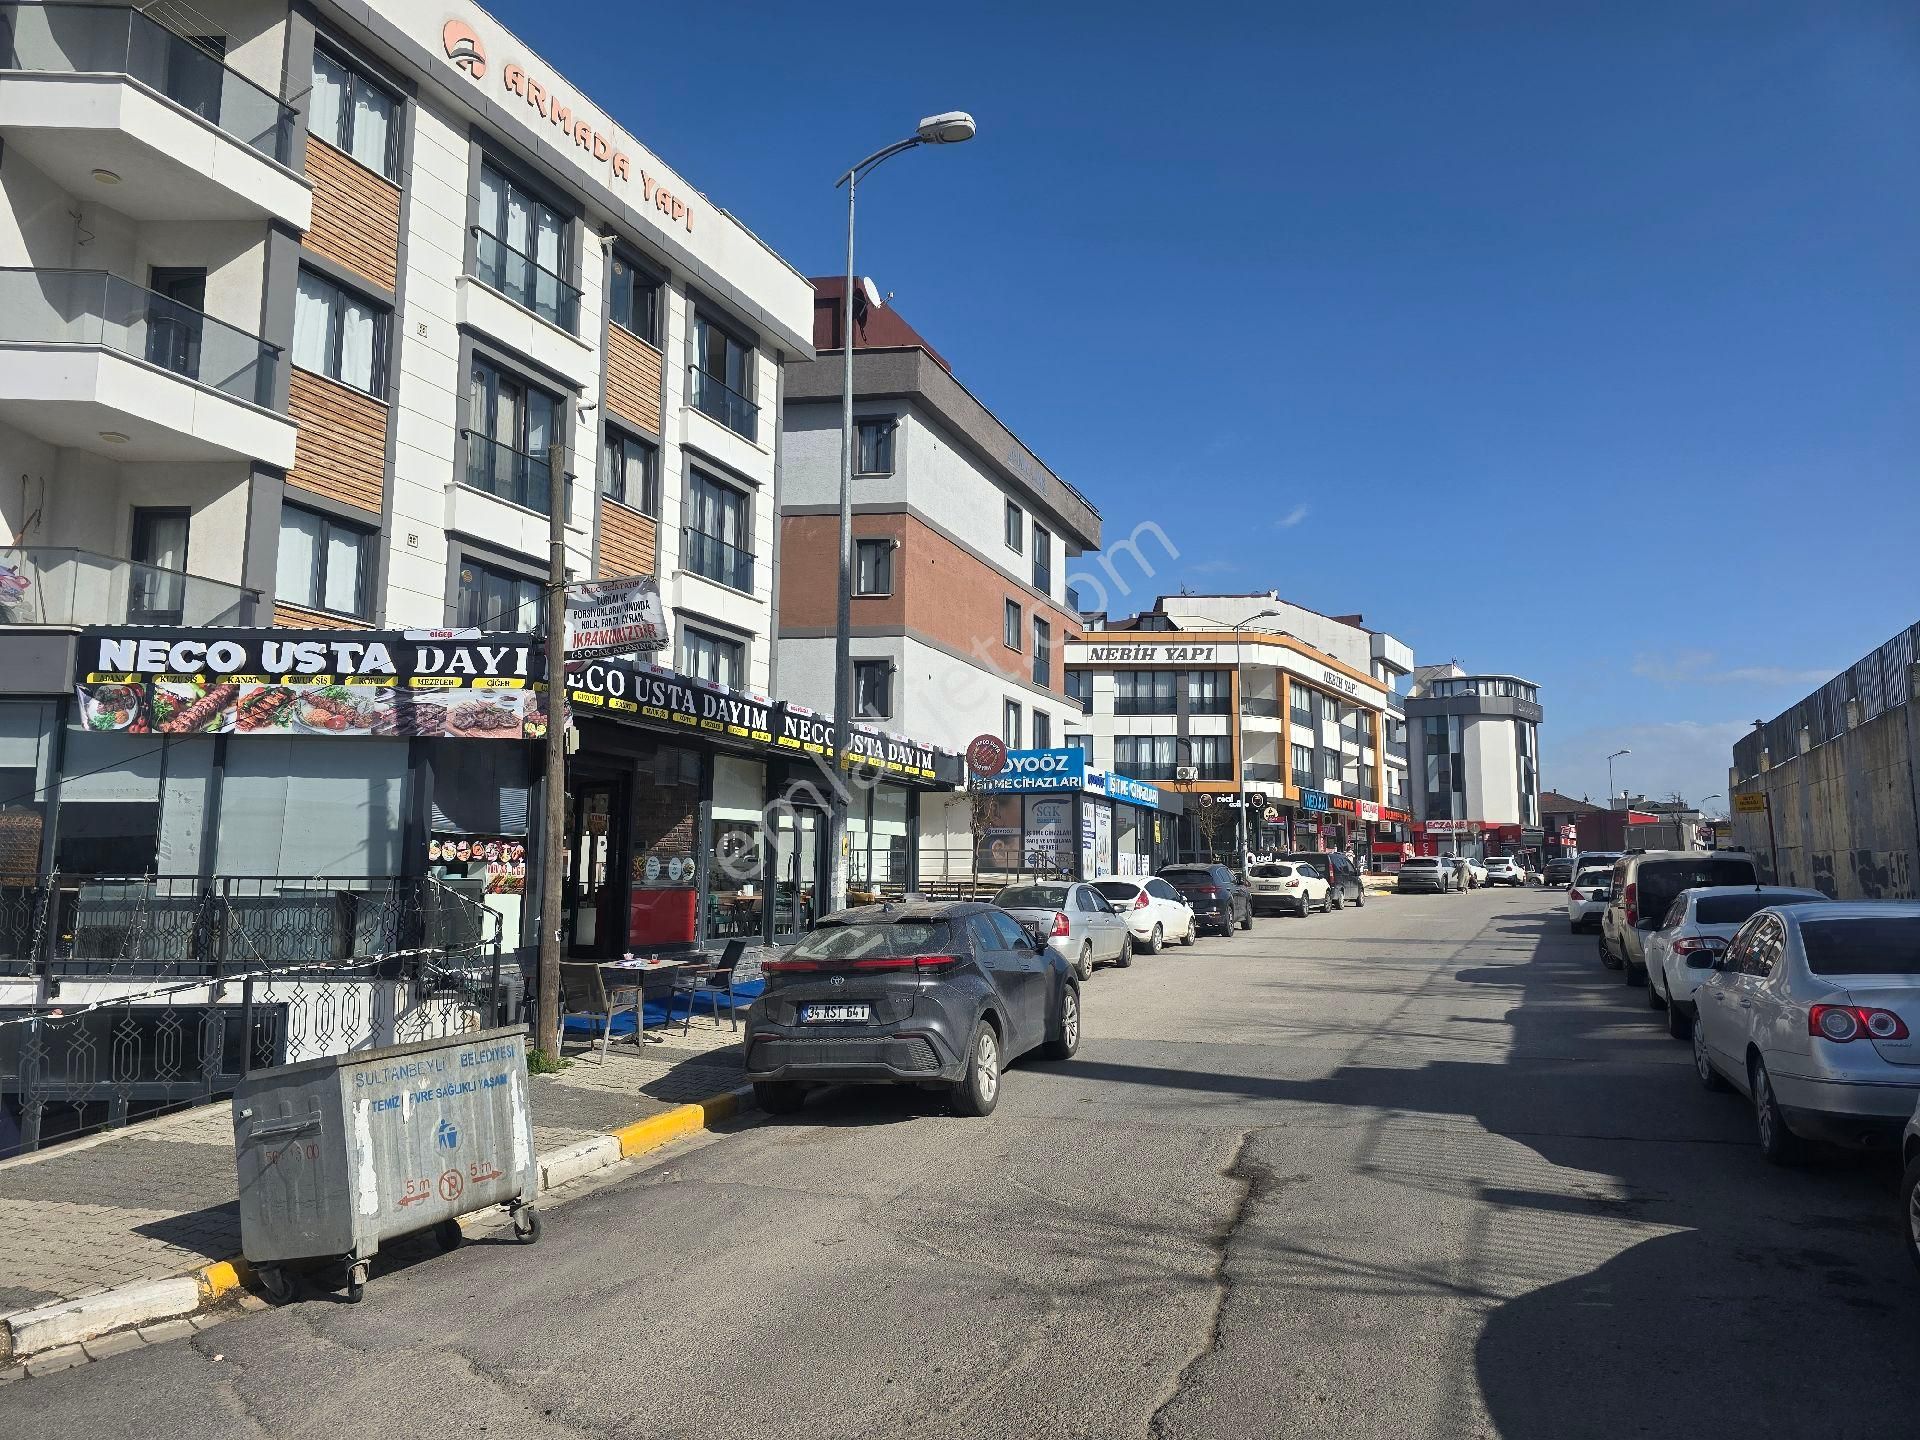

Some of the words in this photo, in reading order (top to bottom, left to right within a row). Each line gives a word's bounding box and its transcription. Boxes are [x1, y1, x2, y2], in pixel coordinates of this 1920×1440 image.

[504, 64, 630, 182] ARMADA
[641, 169, 694, 233] YAPI
[98, 638, 247, 673] NECO
[262, 640, 397, 675] USTA
[1089, 644, 1158, 661] NEBİH
[1165, 647, 1214, 661] YAPI
[160, 675, 184, 683] KUZU
[227, 676, 259, 684] KANAT
[566, 665, 625, 697] ECO
[634, 675, 696, 714] USTA
[703, 693, 768, 731] DAYIM
[887, 743, 933, 770] DAYIM
[1001, 753, 1069, 774] DYOÖZ
[1013, 775, 1082, 789] CİHAZLARI
[1036, 805, 1061, 817] SGK
[808, 1006, 819, 1019] 34
[846, 1005, 865, 1018] 641
[355, 1057, 447, 1088] SULTANBEYLİ
[460, 1044, 515, 1068] BELEDİYESİ
[372, 1095, 401, 1112] TEMİZ
[404, 1089, 434, 1104] EVRE
[436, 1080, 477, 1098] SAĞLIKLI
[478, 1074, 508, 1089] YAŞAM
[470, 1163, 478, 1177] 5
[481, 1161, 492, 1174] m
[406, 1179, 415, 1195] 5
[419, 1178, 430, 1192] m
